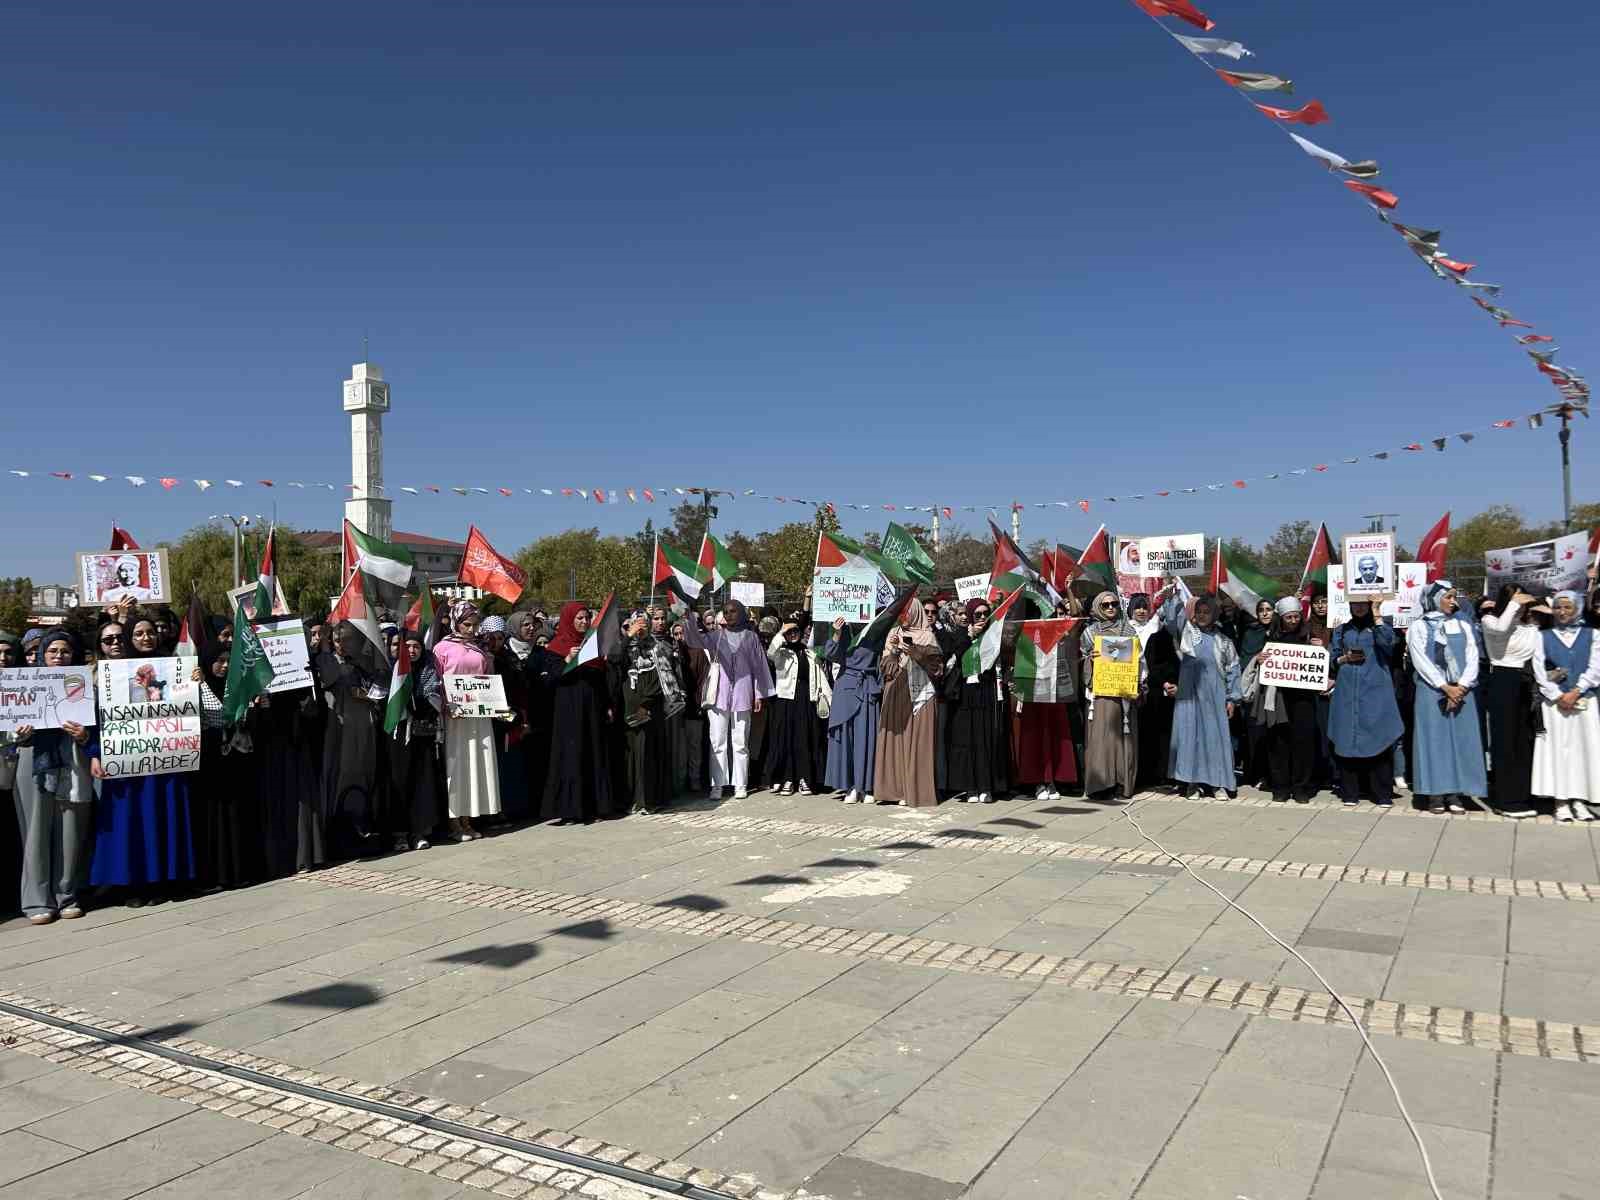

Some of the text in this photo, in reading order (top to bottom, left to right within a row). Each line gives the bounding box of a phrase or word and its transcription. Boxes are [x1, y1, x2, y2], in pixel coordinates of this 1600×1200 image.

[1349, 542, 1388, 550] ARANIYOR
[1265, 659, 1324, 673] ÖLÜRKEN
[1264, 671, 1324, 684] SUSULMAZ
